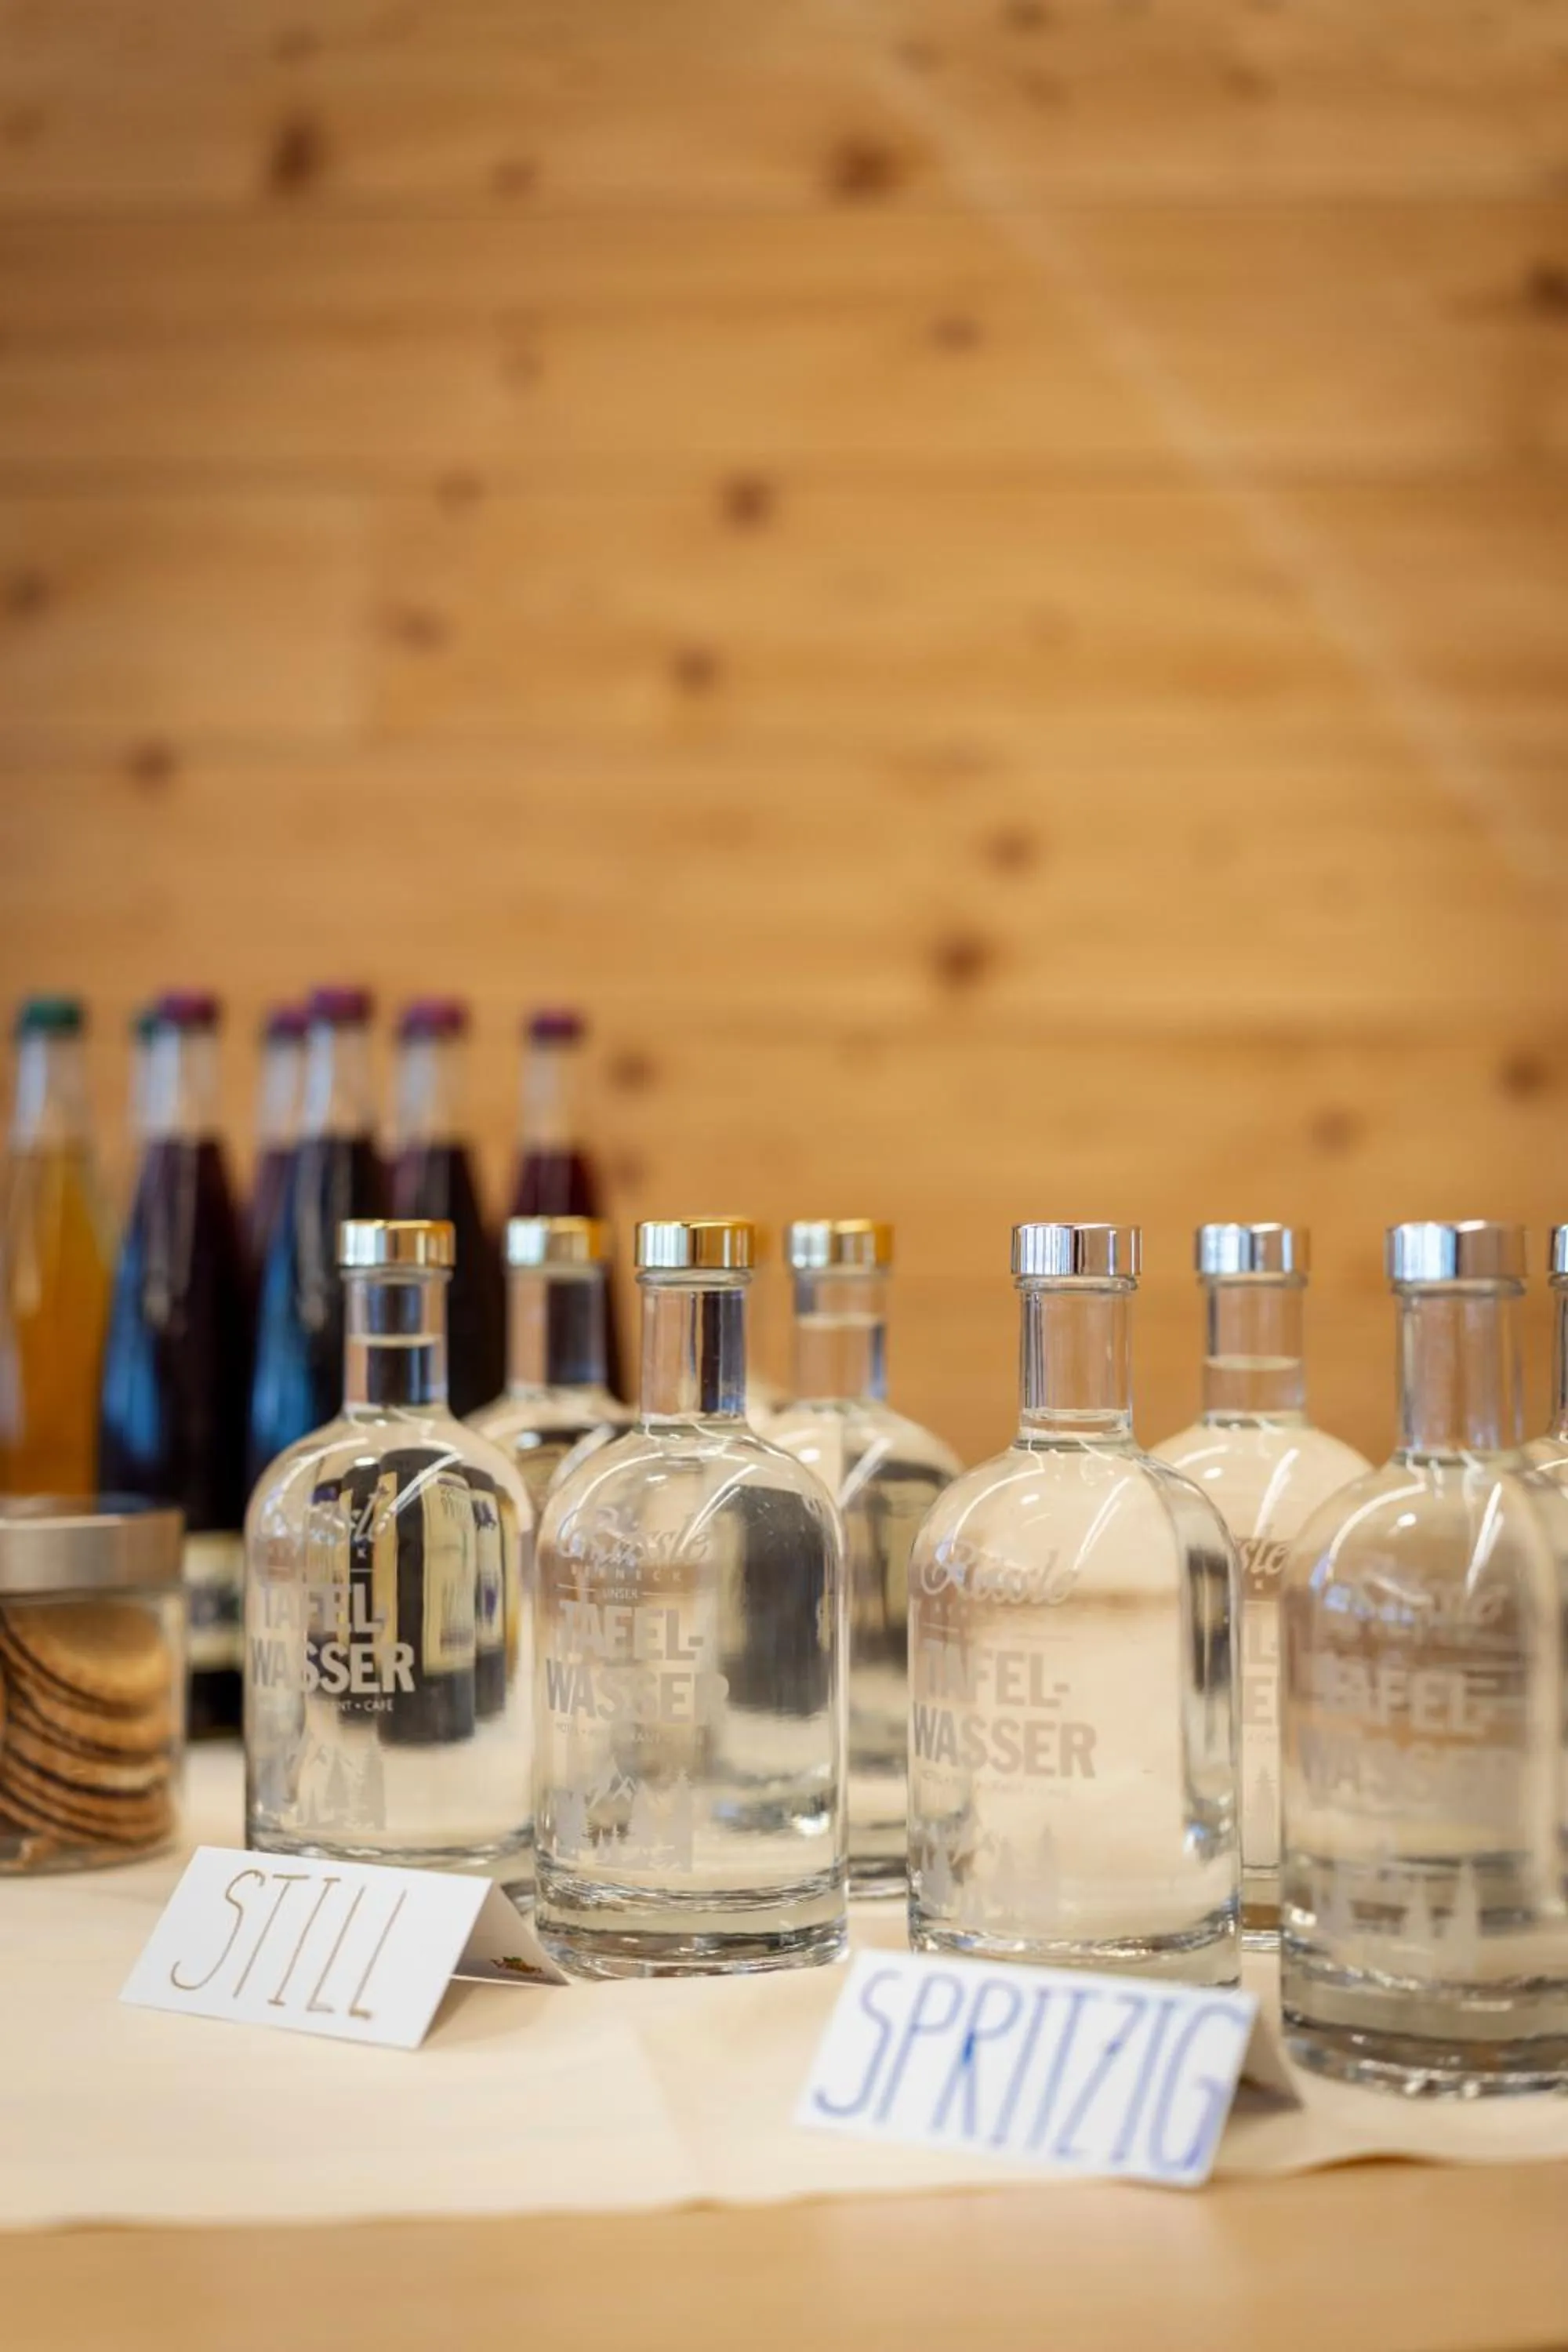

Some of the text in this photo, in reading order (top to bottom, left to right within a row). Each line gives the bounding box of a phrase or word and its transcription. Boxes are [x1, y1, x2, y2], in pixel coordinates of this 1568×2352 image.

[251, 1635, 416, 1694] WASSER
[913, 1700, 1097, 1779] WASSER
[170, 1869, 407, 2020] STILL
[813, 1968, 1248, 2172] SPRITZIG
